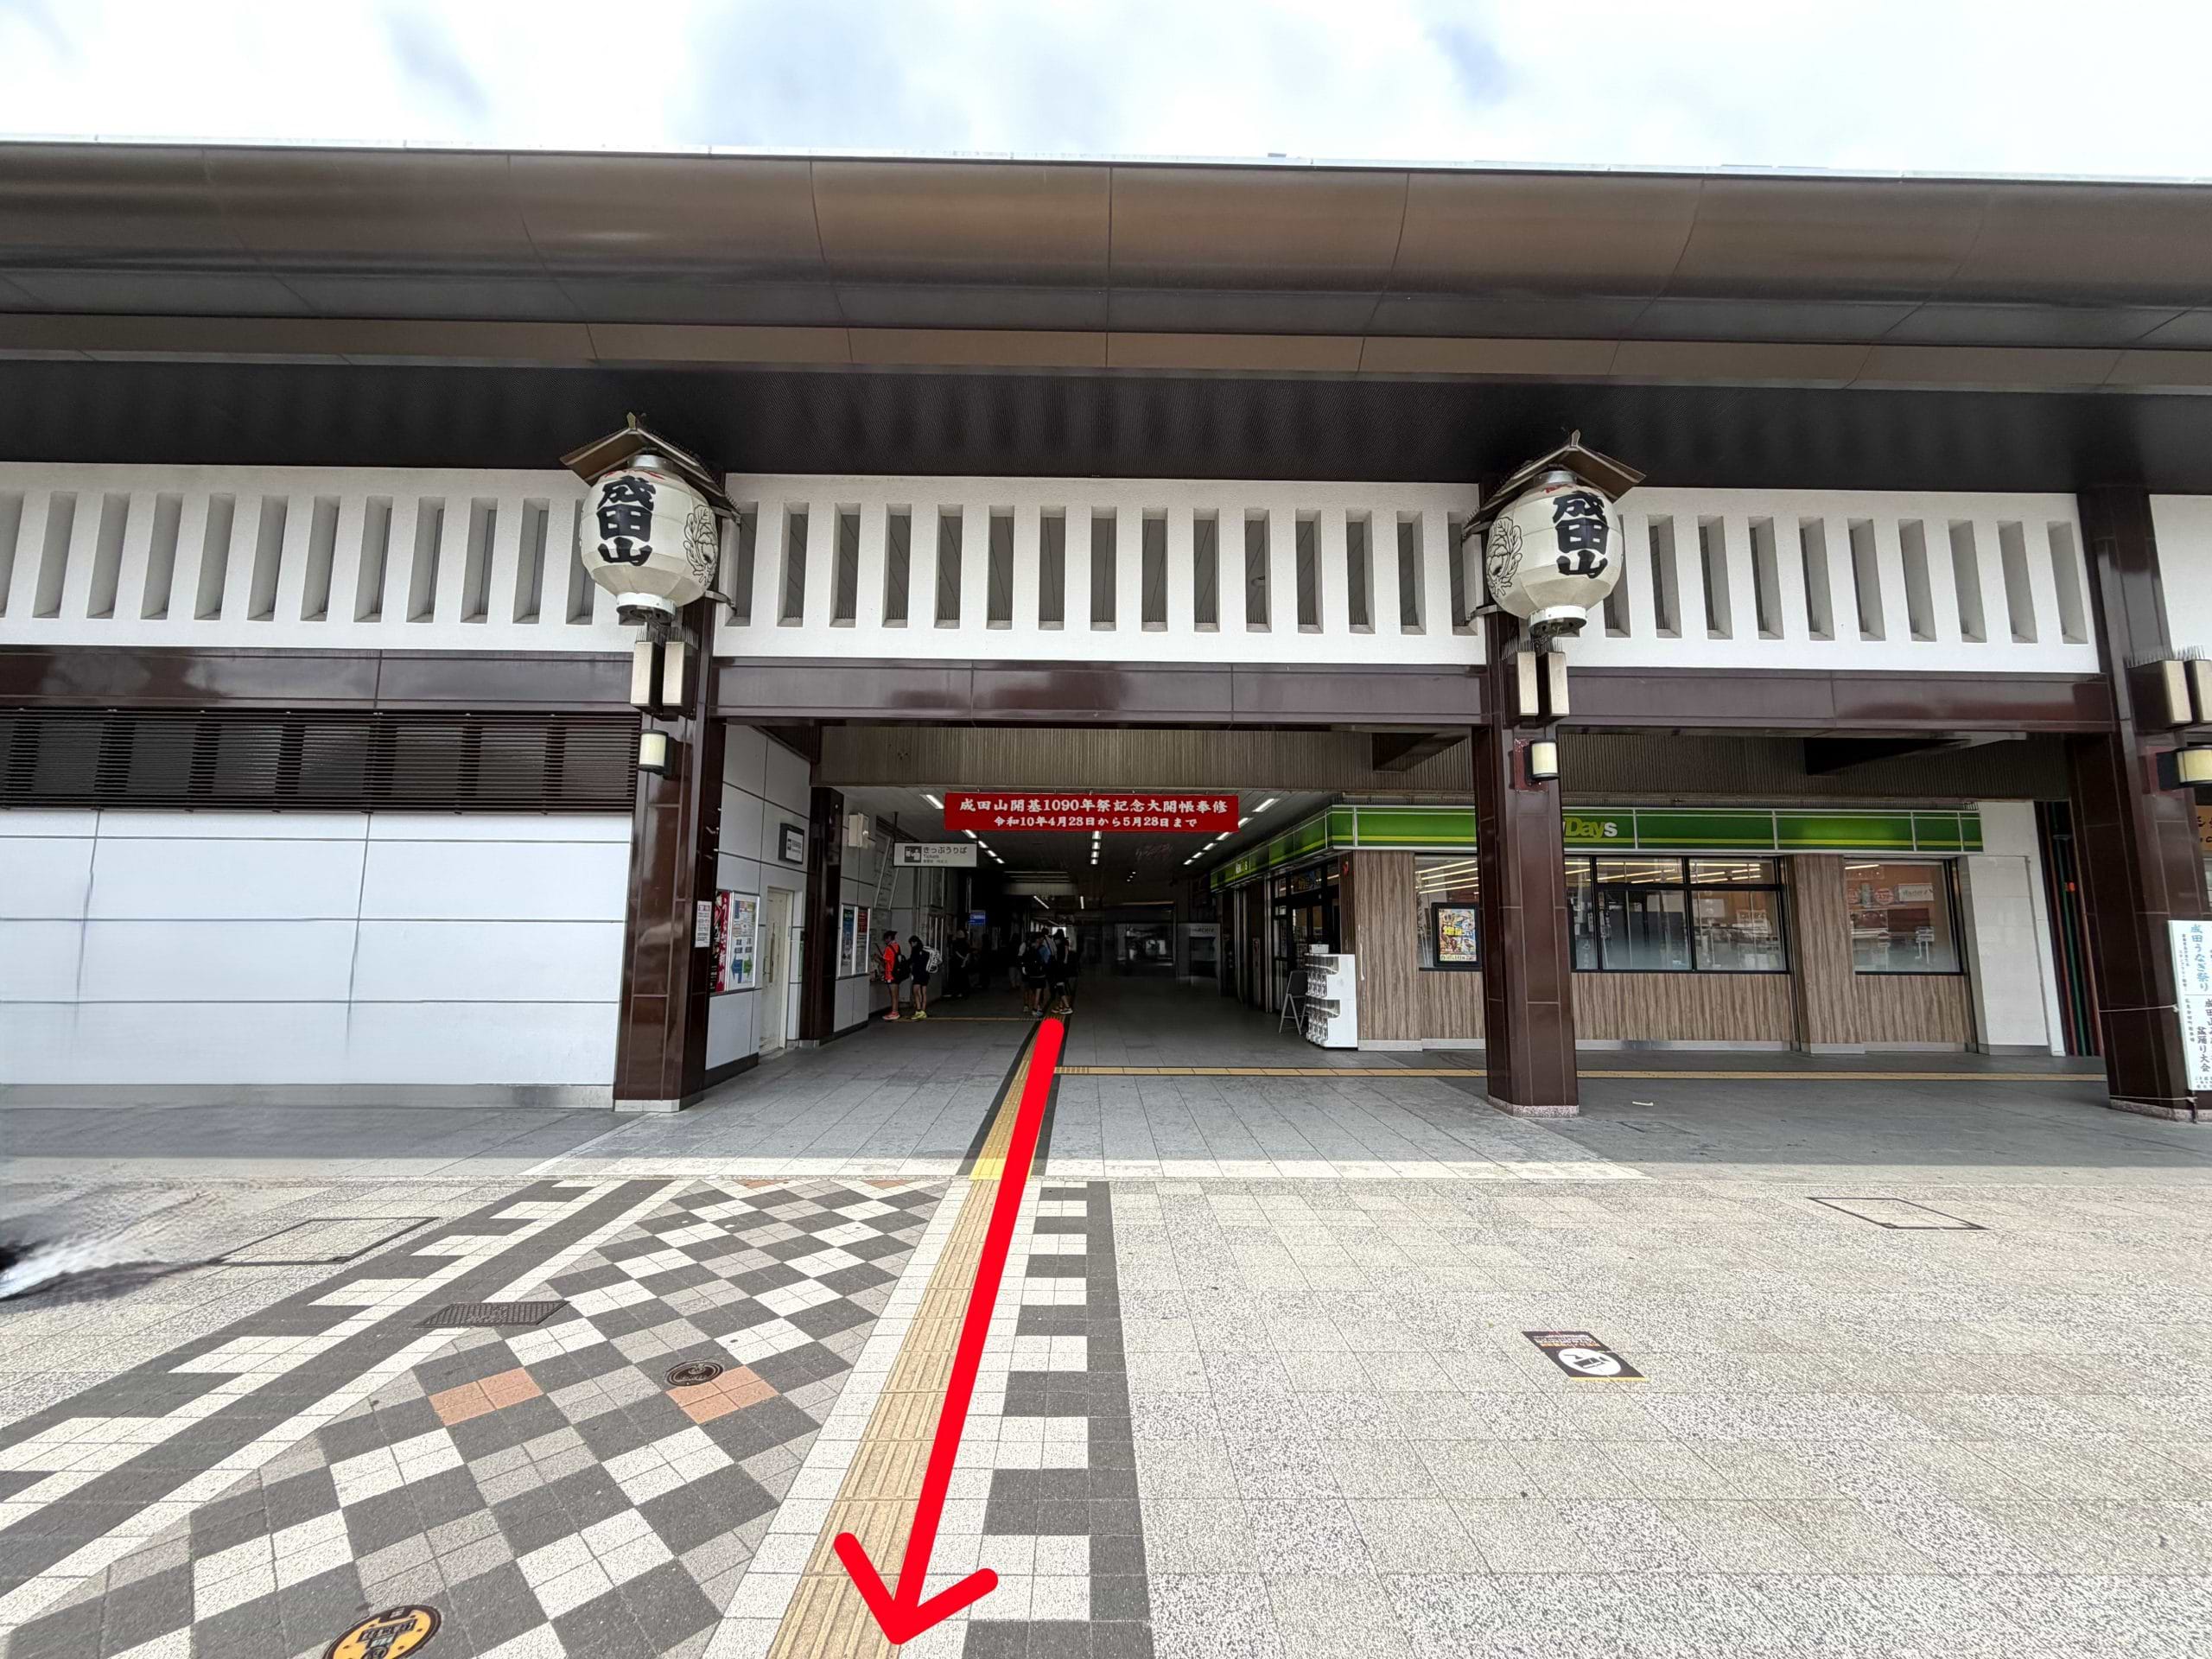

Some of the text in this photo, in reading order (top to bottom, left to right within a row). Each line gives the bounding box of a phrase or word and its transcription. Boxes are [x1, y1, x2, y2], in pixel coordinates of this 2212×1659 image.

[595, 474, 656, 567] 成田山
[1552, 490, 1609, 579] 成田山
[959, 798, 1229, 814] 成田山開基1090年祭記念大開帳奉修
[994, 815, 1198, 829] 令和10年4月28日から5月28日まで
[1563, 817, 1618, 840] Days
[2190, 924, 2209, 992] 成田うなぎ祭り
